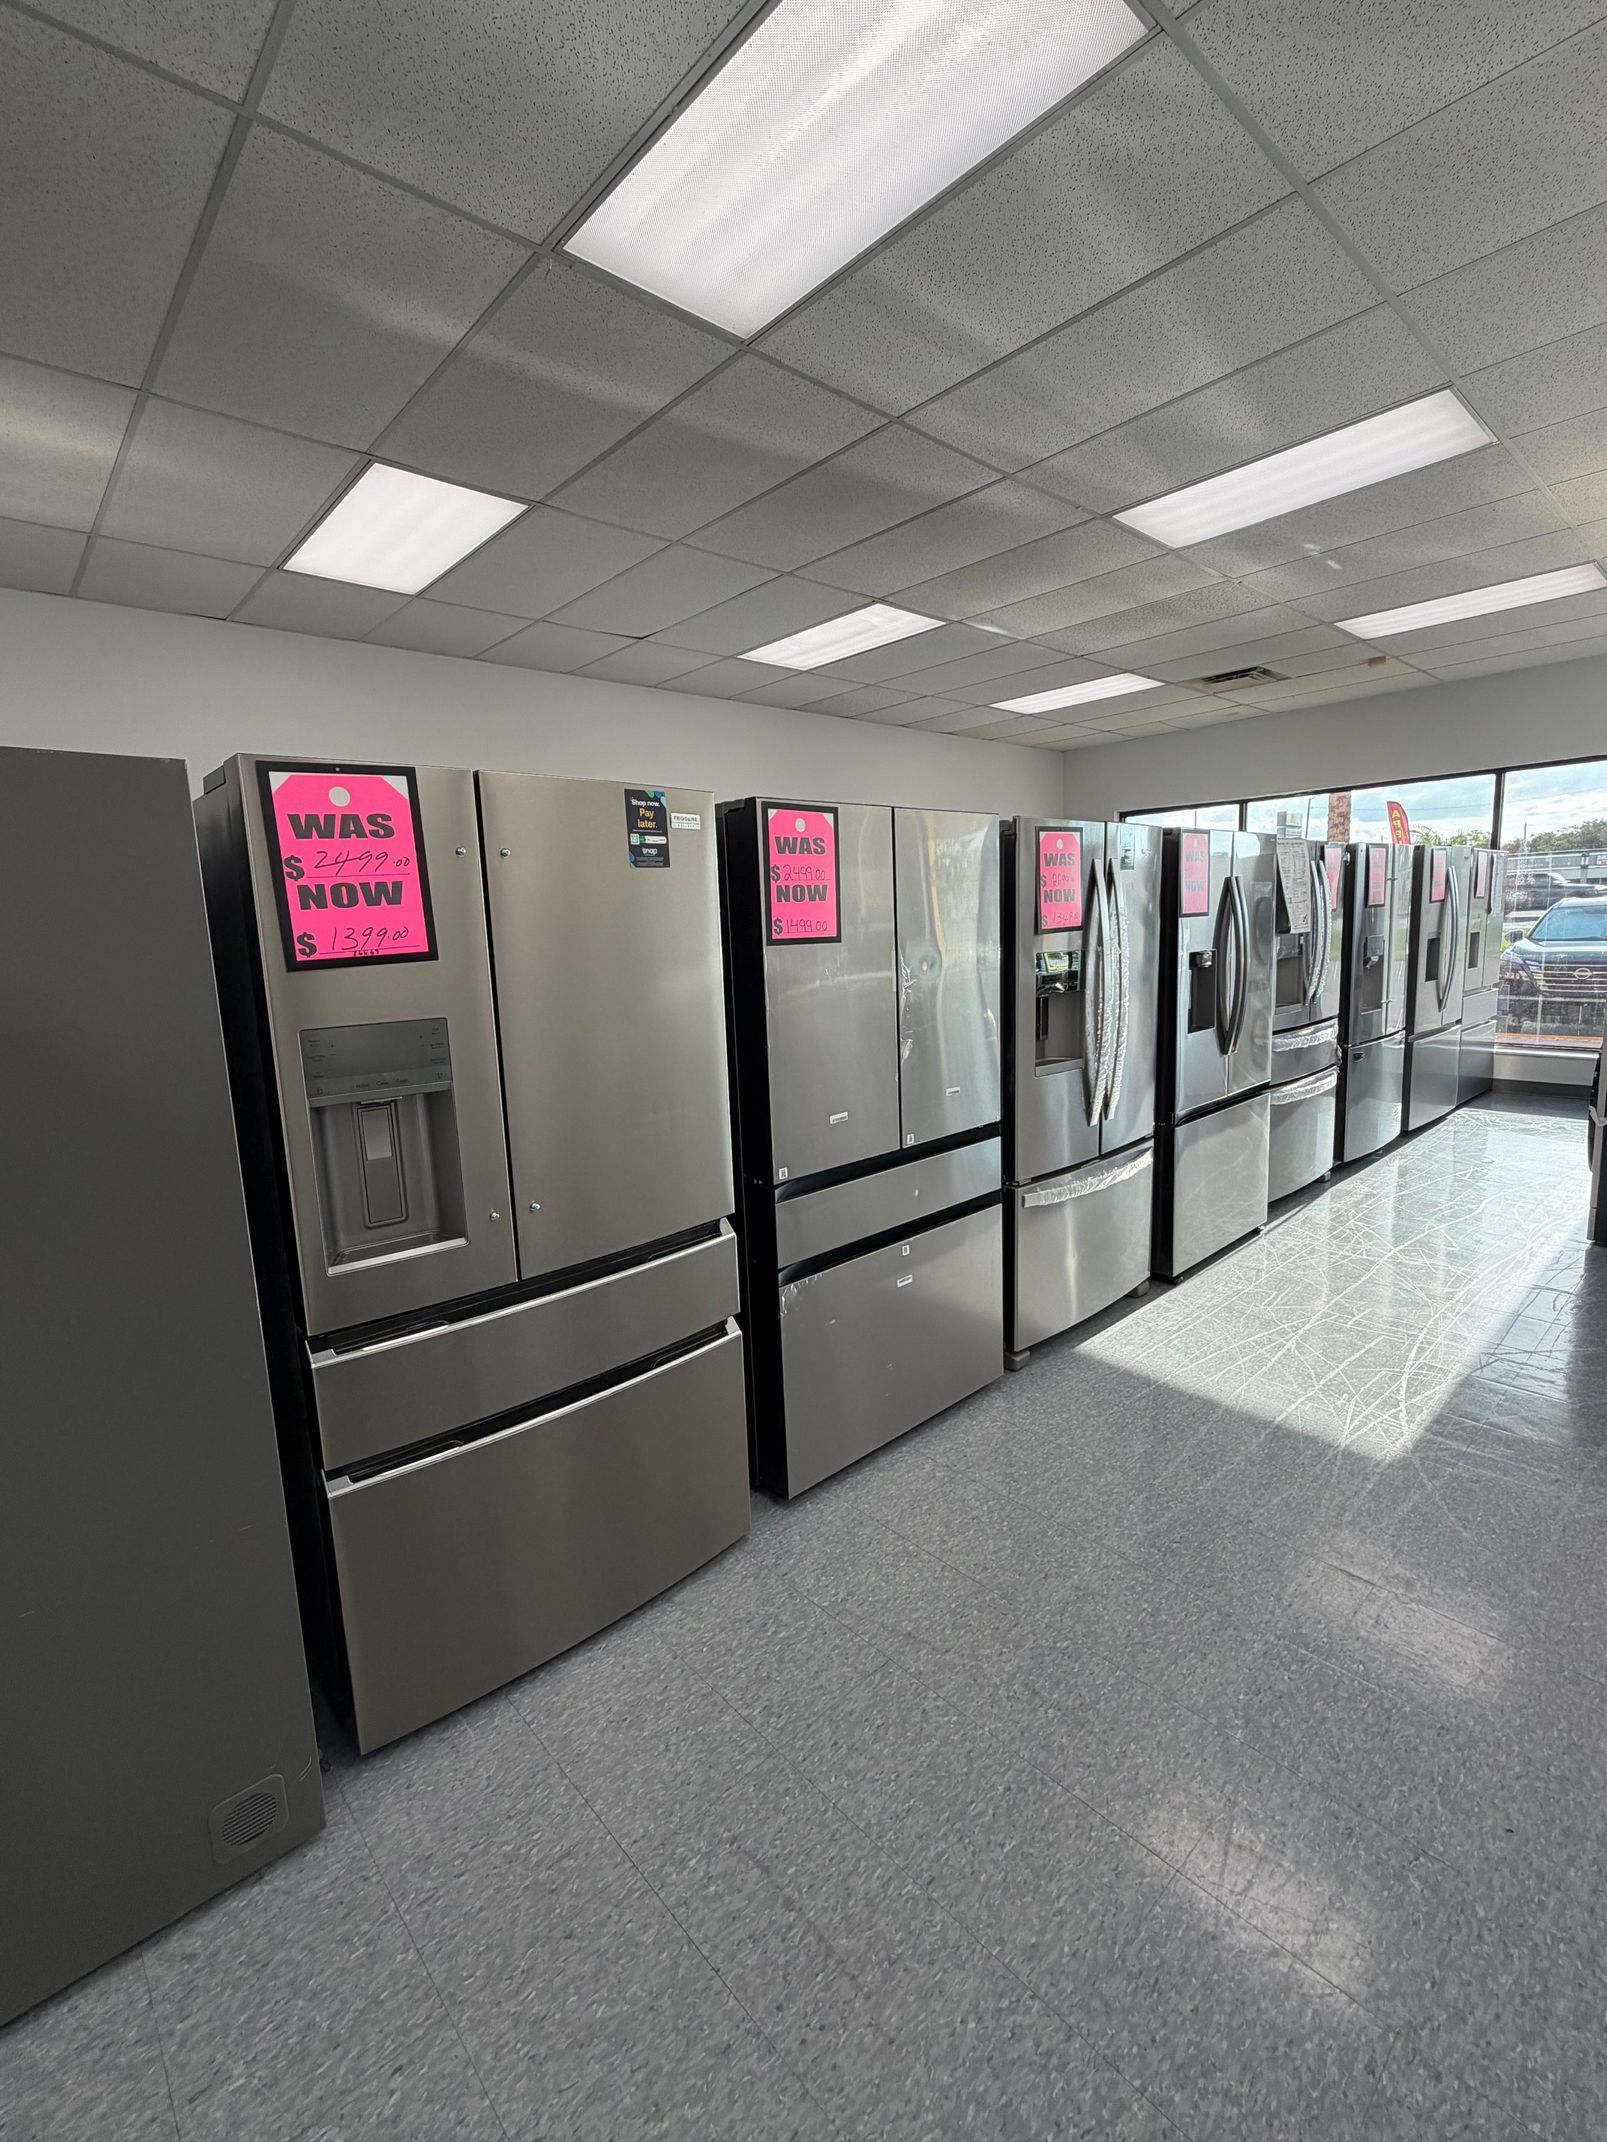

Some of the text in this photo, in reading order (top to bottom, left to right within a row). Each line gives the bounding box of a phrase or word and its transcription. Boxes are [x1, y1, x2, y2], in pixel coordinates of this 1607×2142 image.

[631, 798, 647, 807] Shop
[639, 808, 654, 819] Pay
[287, 813, 395, 840] WAS
[637, 819, 658, 829] later.
[774, 836, 826, 855] WAS
[284, 855, 305, 882] $
[1043, 853, 1075, 867] WAS
[771, 864, 781, 883] $
[297, 881, 403, 910] NOW
[776, 884, 828, 903] NOW
[1043, 889, 1075, 903] NOW
[773, 918, 783, 936] $
[296, 931, 317, 958] $
